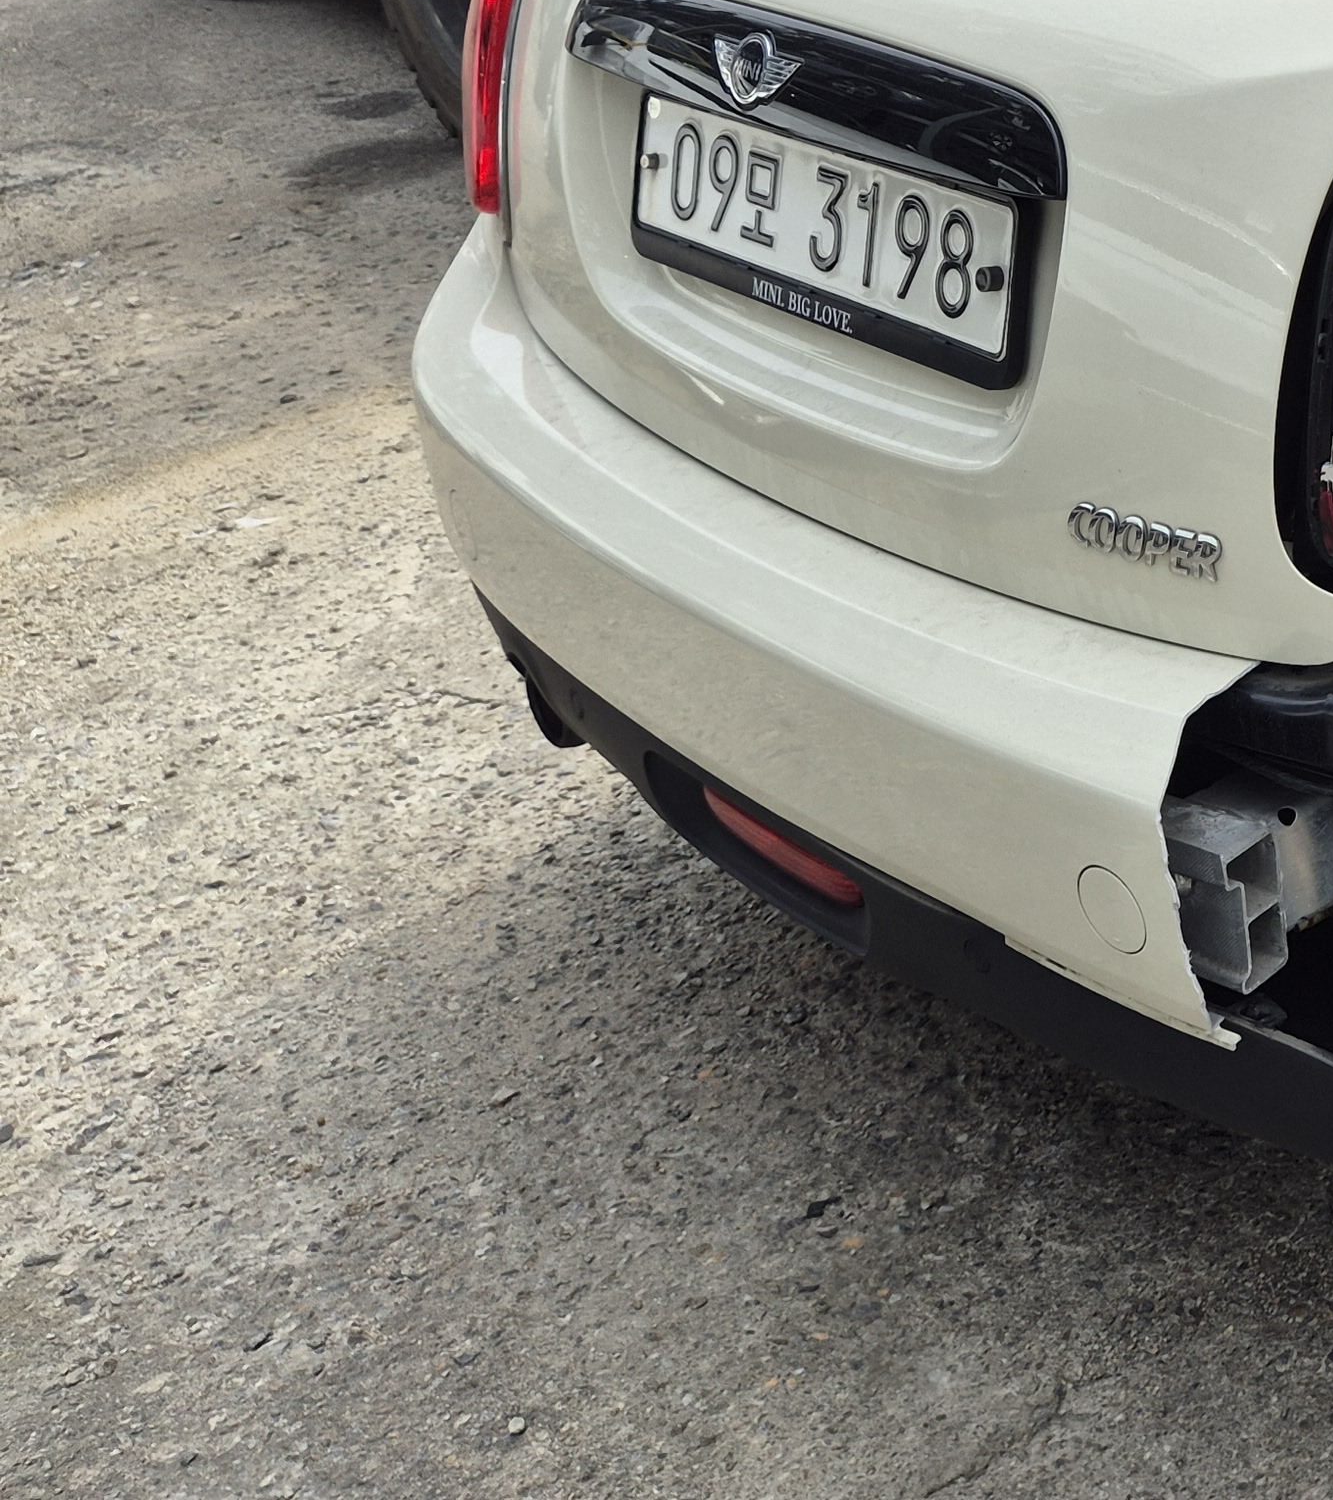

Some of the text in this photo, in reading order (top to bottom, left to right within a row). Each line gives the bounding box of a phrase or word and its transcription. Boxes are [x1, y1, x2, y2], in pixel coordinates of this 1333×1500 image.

[670, 122, 975, 319] 09모 3198
[752, 276, 853, 334] MINI. BIG LOVE.
[1067, 501, 1223, 583] COOPER
